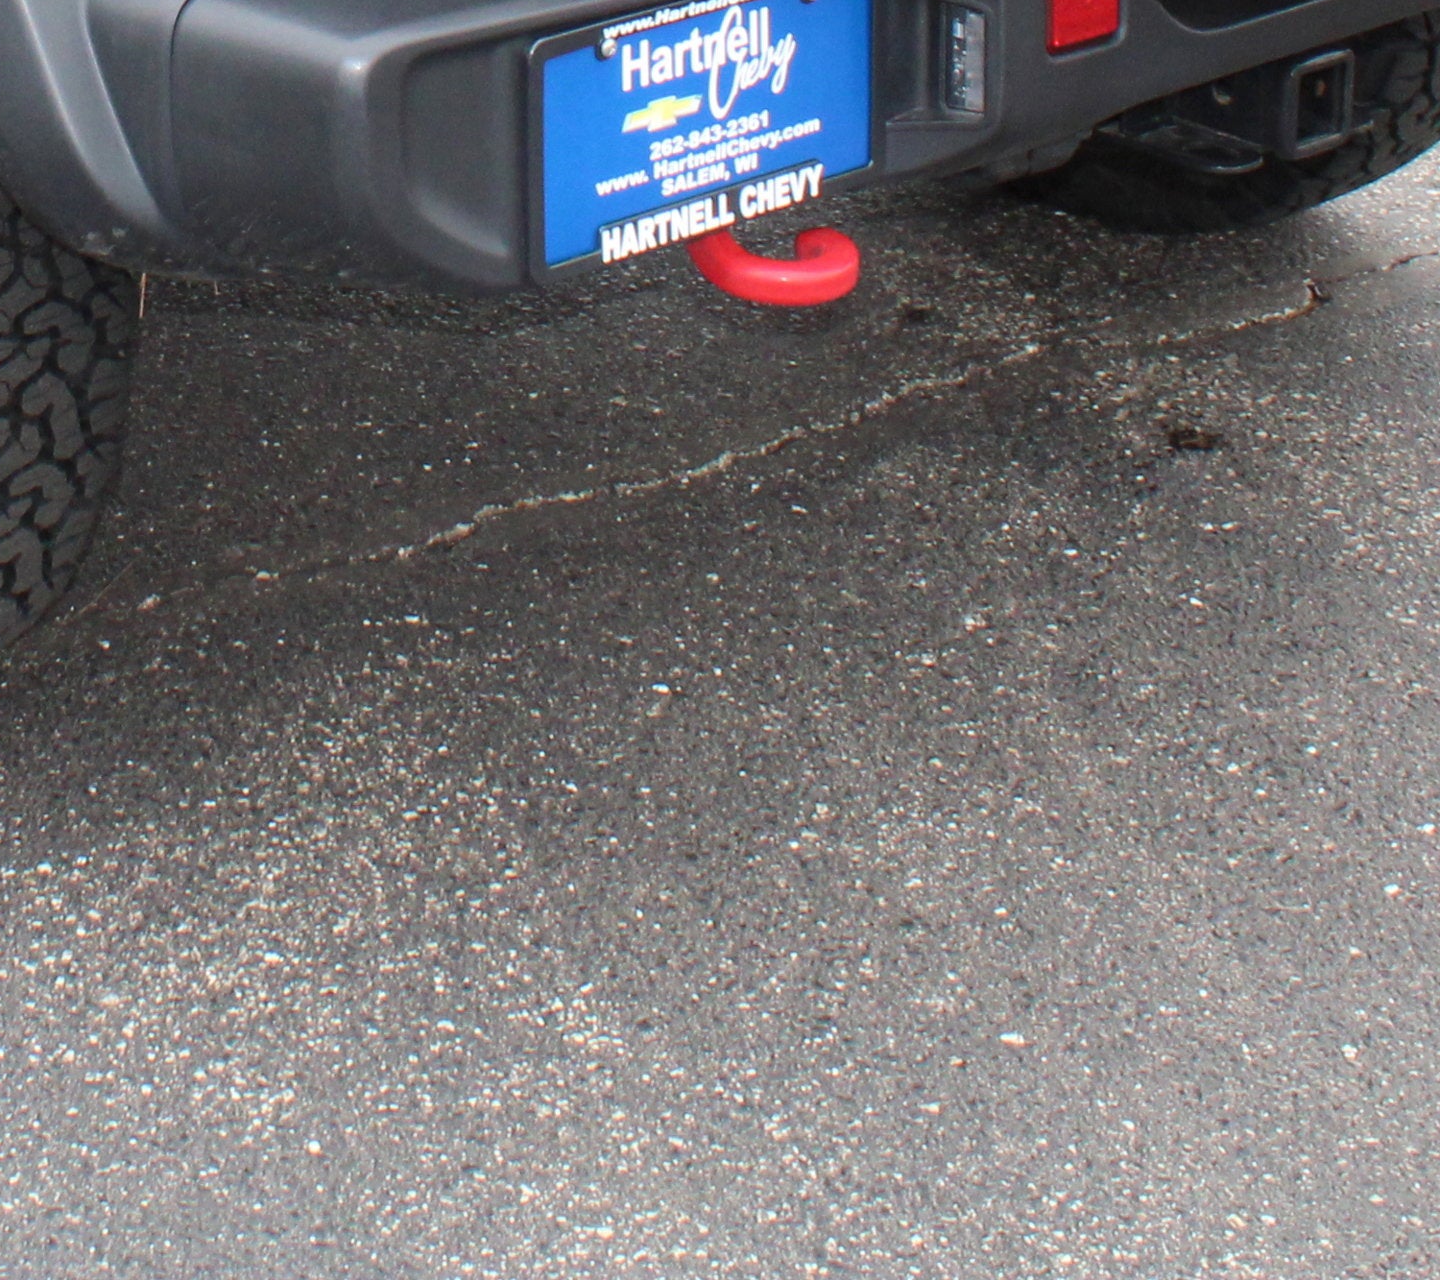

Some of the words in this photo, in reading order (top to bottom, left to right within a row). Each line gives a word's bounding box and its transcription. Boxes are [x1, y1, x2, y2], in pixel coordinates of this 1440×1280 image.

[621, 5, 769, 92] Hartnell
[708, 4, 797, 119] Chevy
[649, 108, 770, 161] 262-843-2361
[661, 162, 731, 197] SALEM,
[734, 151, 759, 175] WI
[600, 192, 735, 265] HARTNELL
[739, 162, 824, 219] CHEVY
